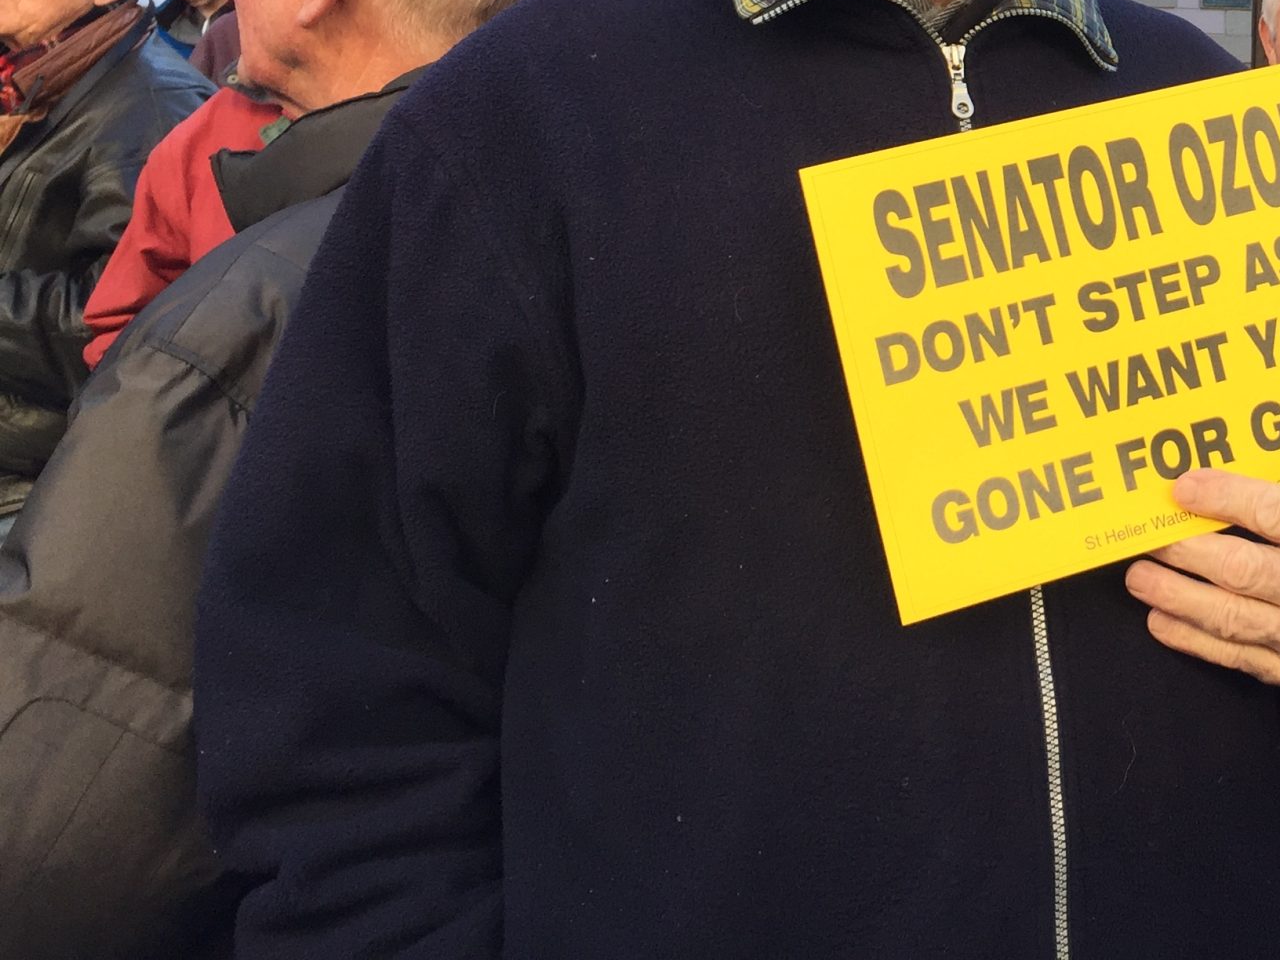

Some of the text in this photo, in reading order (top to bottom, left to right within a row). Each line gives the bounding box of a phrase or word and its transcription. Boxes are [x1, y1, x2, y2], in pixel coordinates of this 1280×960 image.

[872, 136, 1164, 300] SENATOR
[875, 293, 1057, 385] DON'T
[1076, 254, 1222, 334] STEP
[958, 379, 1058, 448] WE
[1064, 331, 1229, 419] WANT
[930, 452, 1104, 545] GONE
[1114, 416, 1236, 493] FOR
[1084, 533, 1103, 551] St
[1104, 522, 1148, 545] Helier
